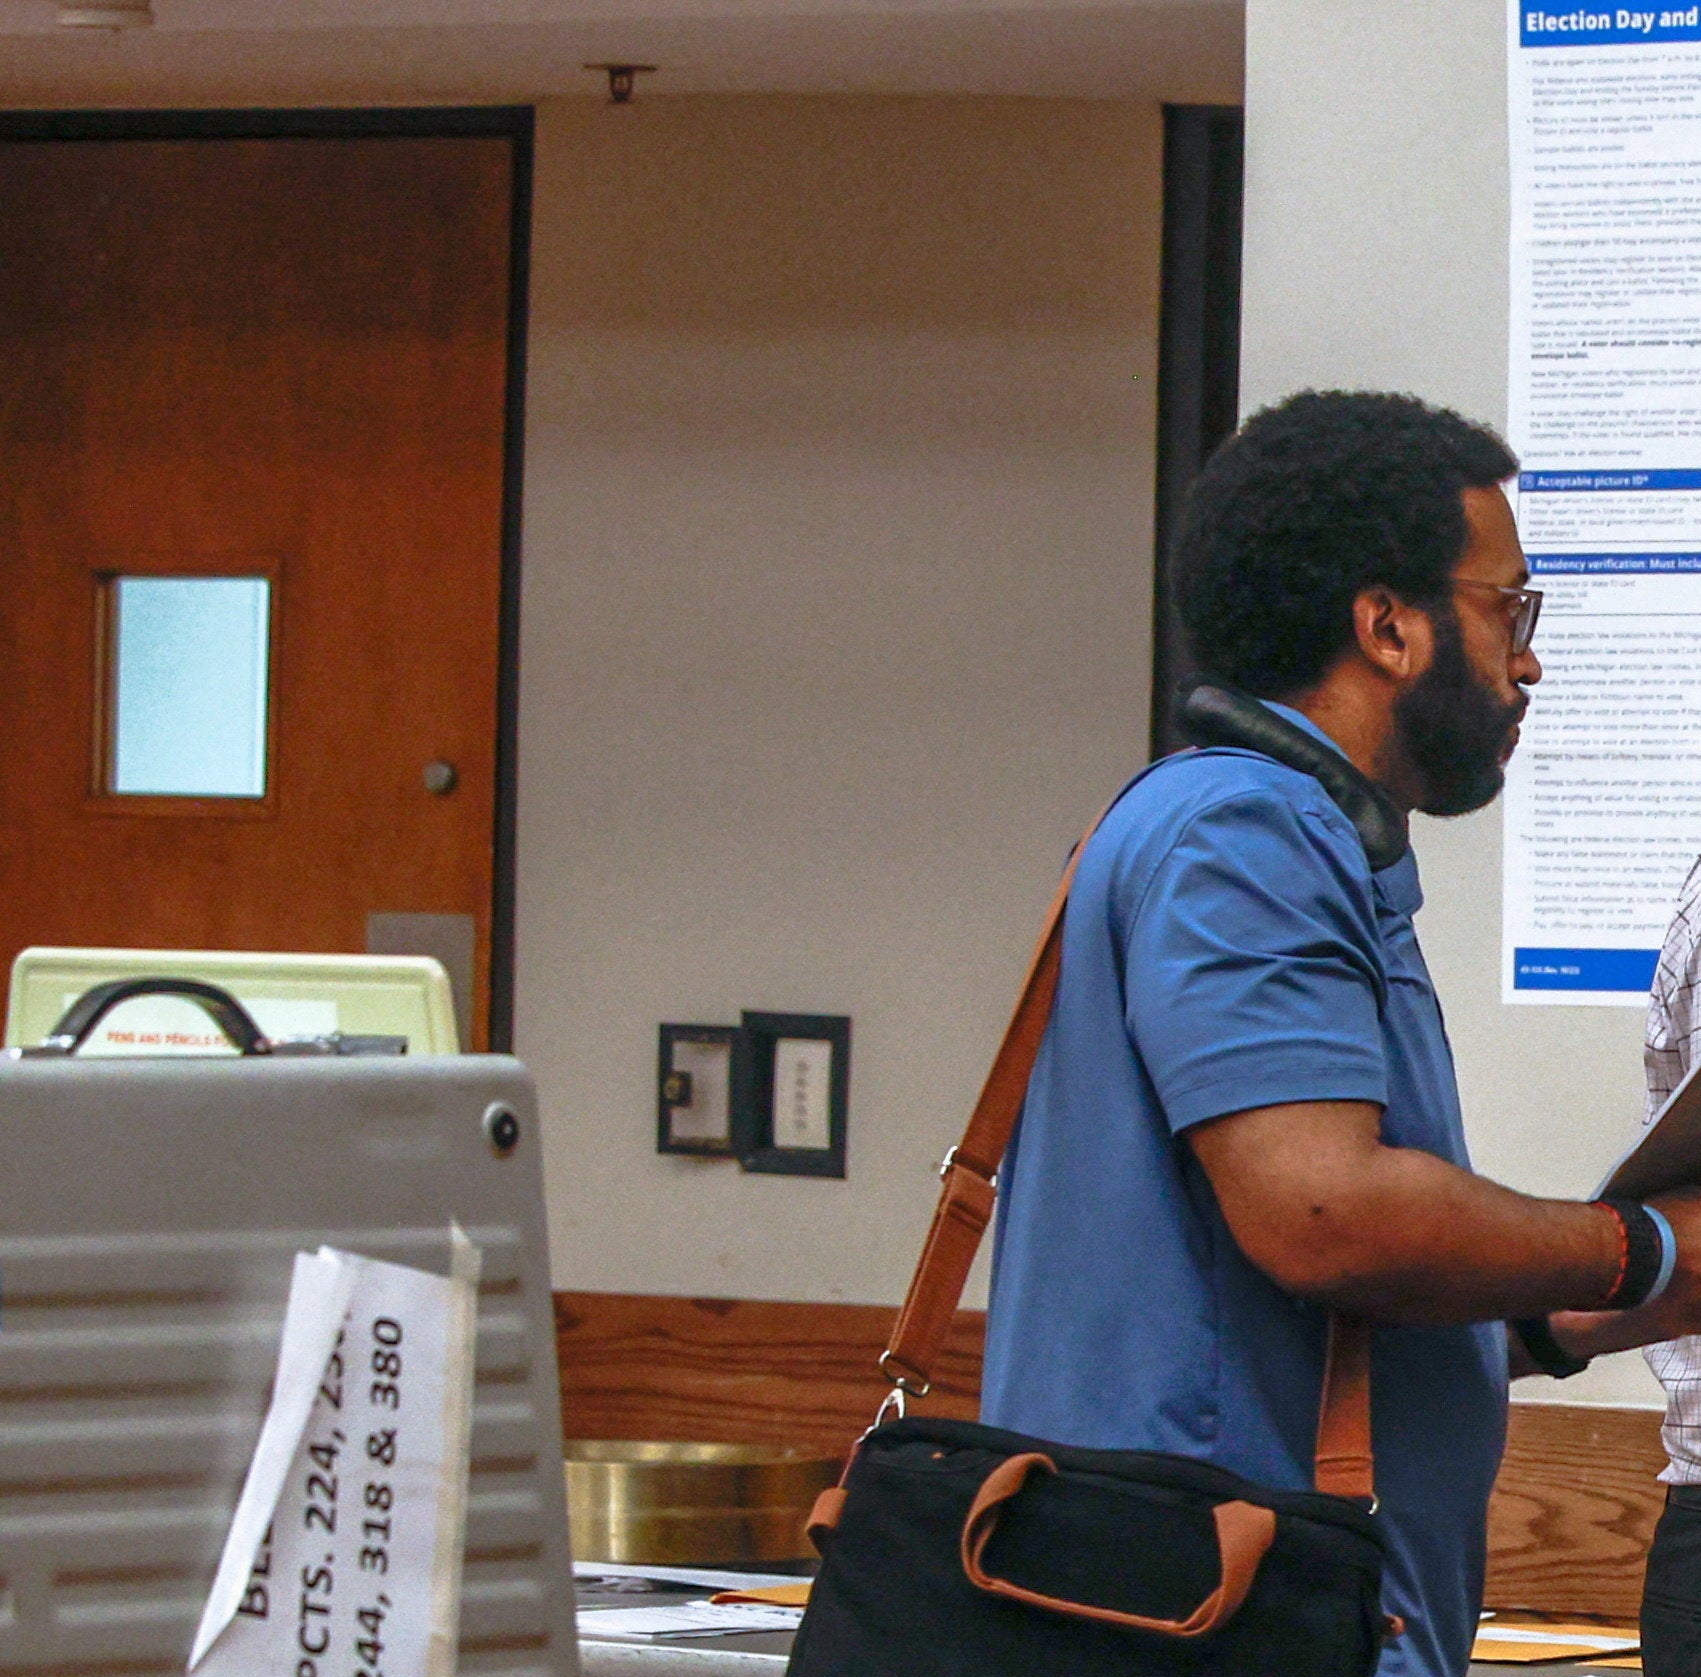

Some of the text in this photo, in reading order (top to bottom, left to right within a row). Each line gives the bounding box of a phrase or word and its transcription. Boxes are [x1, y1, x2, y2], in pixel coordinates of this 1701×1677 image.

[1526, 10, 1611, 33] Election
[1616, 9, 1655, 34] Day
[1659, 7, 1698, 27] and
[1537, 475, 1592, 489] Acceptable
[1595, 475, 1629, 489] picture
[1536, 559, 1585, 572] Residency
[1650, 559, 1675, 569] Must
[370, 1316, 403, 1410] 380
[365, 1429, 398, 1467] &
[304, 1430, 345, 1535] 224,
[358, 1481, 394, 1576] 318
